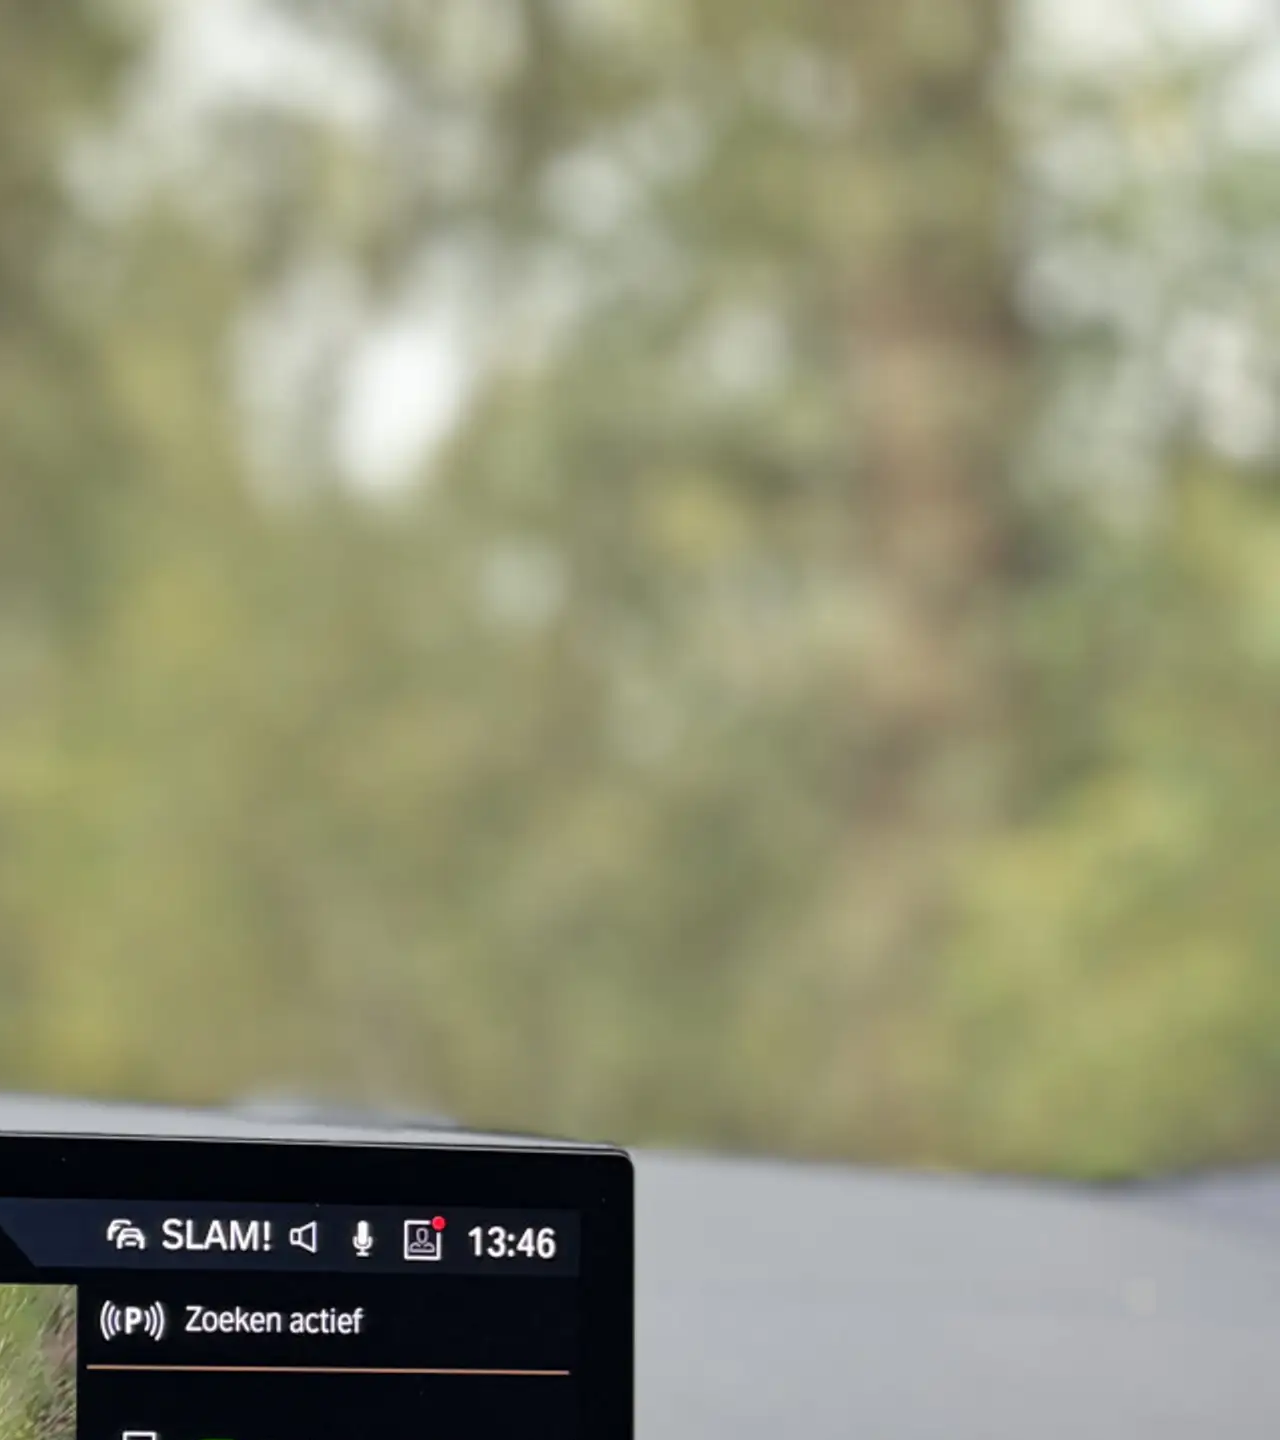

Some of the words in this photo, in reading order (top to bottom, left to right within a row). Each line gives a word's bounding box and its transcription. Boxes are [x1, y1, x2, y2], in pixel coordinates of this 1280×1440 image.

[161, 1217, 272, 1253] SLAM!
[467, 1225, 558, 1260] 13:46
[184, 1304, 282, 1334] Zoeken
[288, 1305, 364, 1336] actief
